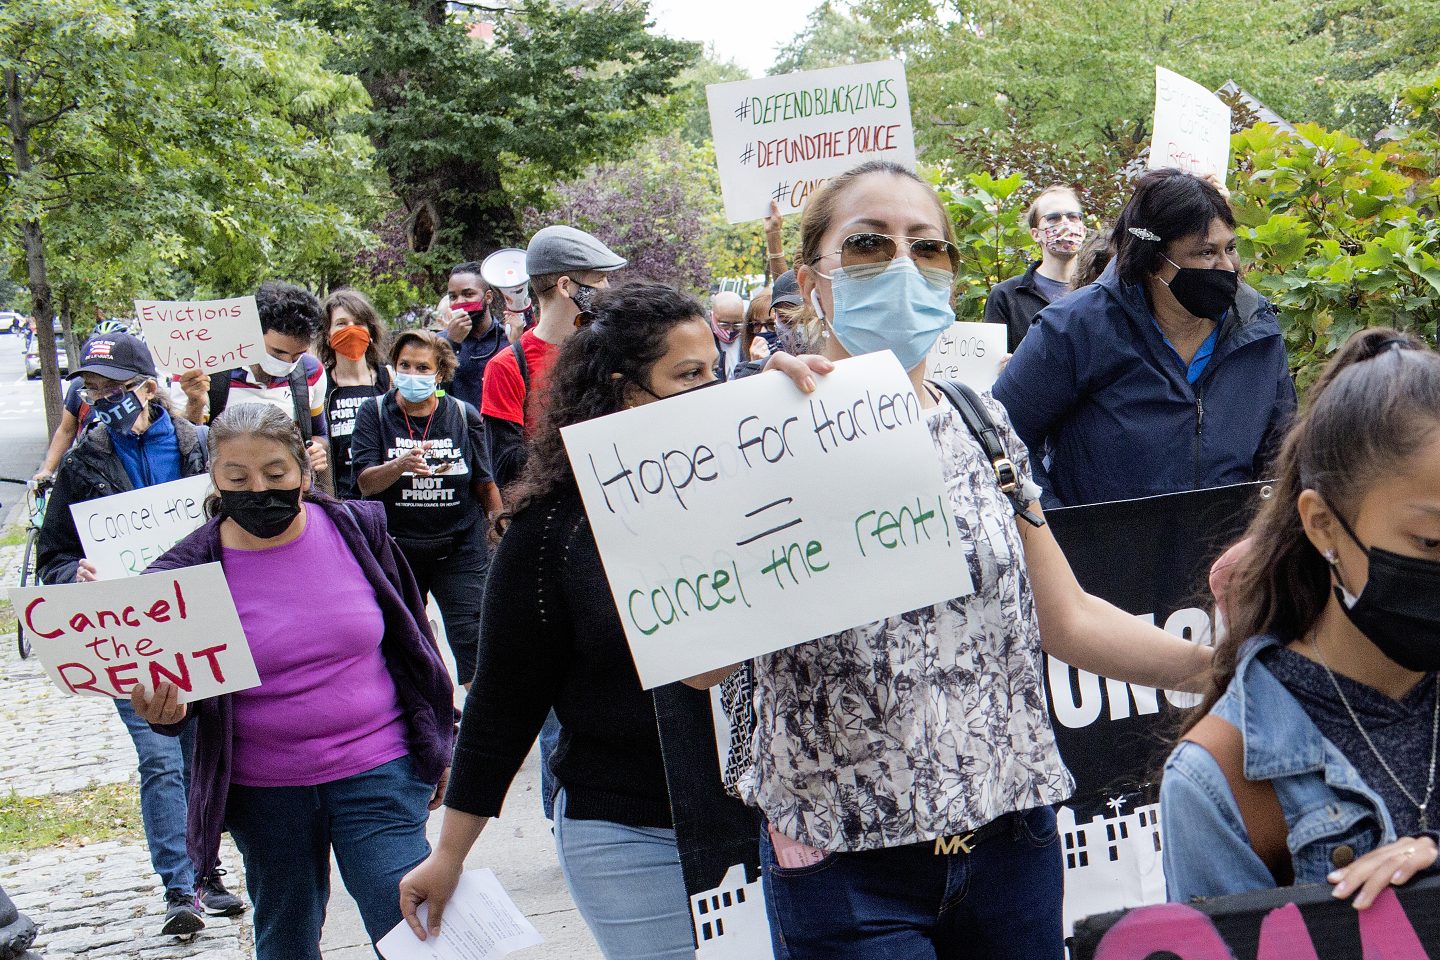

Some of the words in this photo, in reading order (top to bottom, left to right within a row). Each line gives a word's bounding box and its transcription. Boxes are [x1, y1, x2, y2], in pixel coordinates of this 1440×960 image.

[142, 305, 242, 321] Evictions
[170, 328, 212, 341] are
[153, 343, 255, 369] Violent
[589, 442, 718, 513] Hope
[810, 389, 920, 453] Harlem
[402, 489, 456, 500] PROFIT
[412, 477, 443, 489] NOT
[88, 503, 160, 542] Cancel
[164, 497, 202, 523] the
[761, 538, 831, 590] the
[24, 580, 187, 639] Cancel
[85, 636, 164, 661] the
[57, 643, 227, 698] RENT
[934, 834, 974, 855] MK
